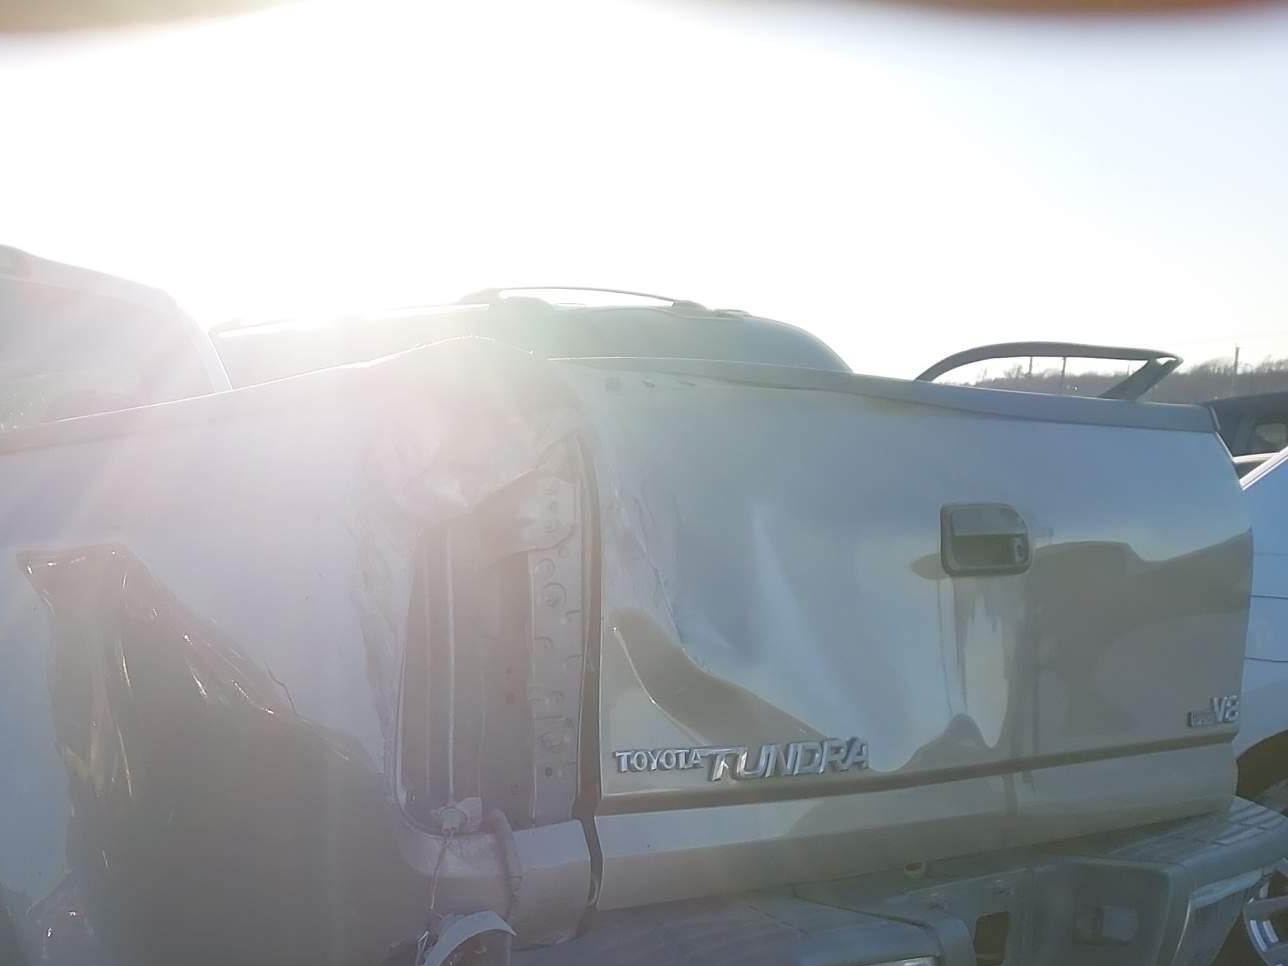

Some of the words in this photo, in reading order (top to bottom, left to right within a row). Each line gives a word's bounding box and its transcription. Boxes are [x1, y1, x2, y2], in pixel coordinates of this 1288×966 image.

[1211, 694, 1241, 723] V8
[615, 748, 705, 773] TOYOTA
[704, 737, 872, 782] TUNDRA
